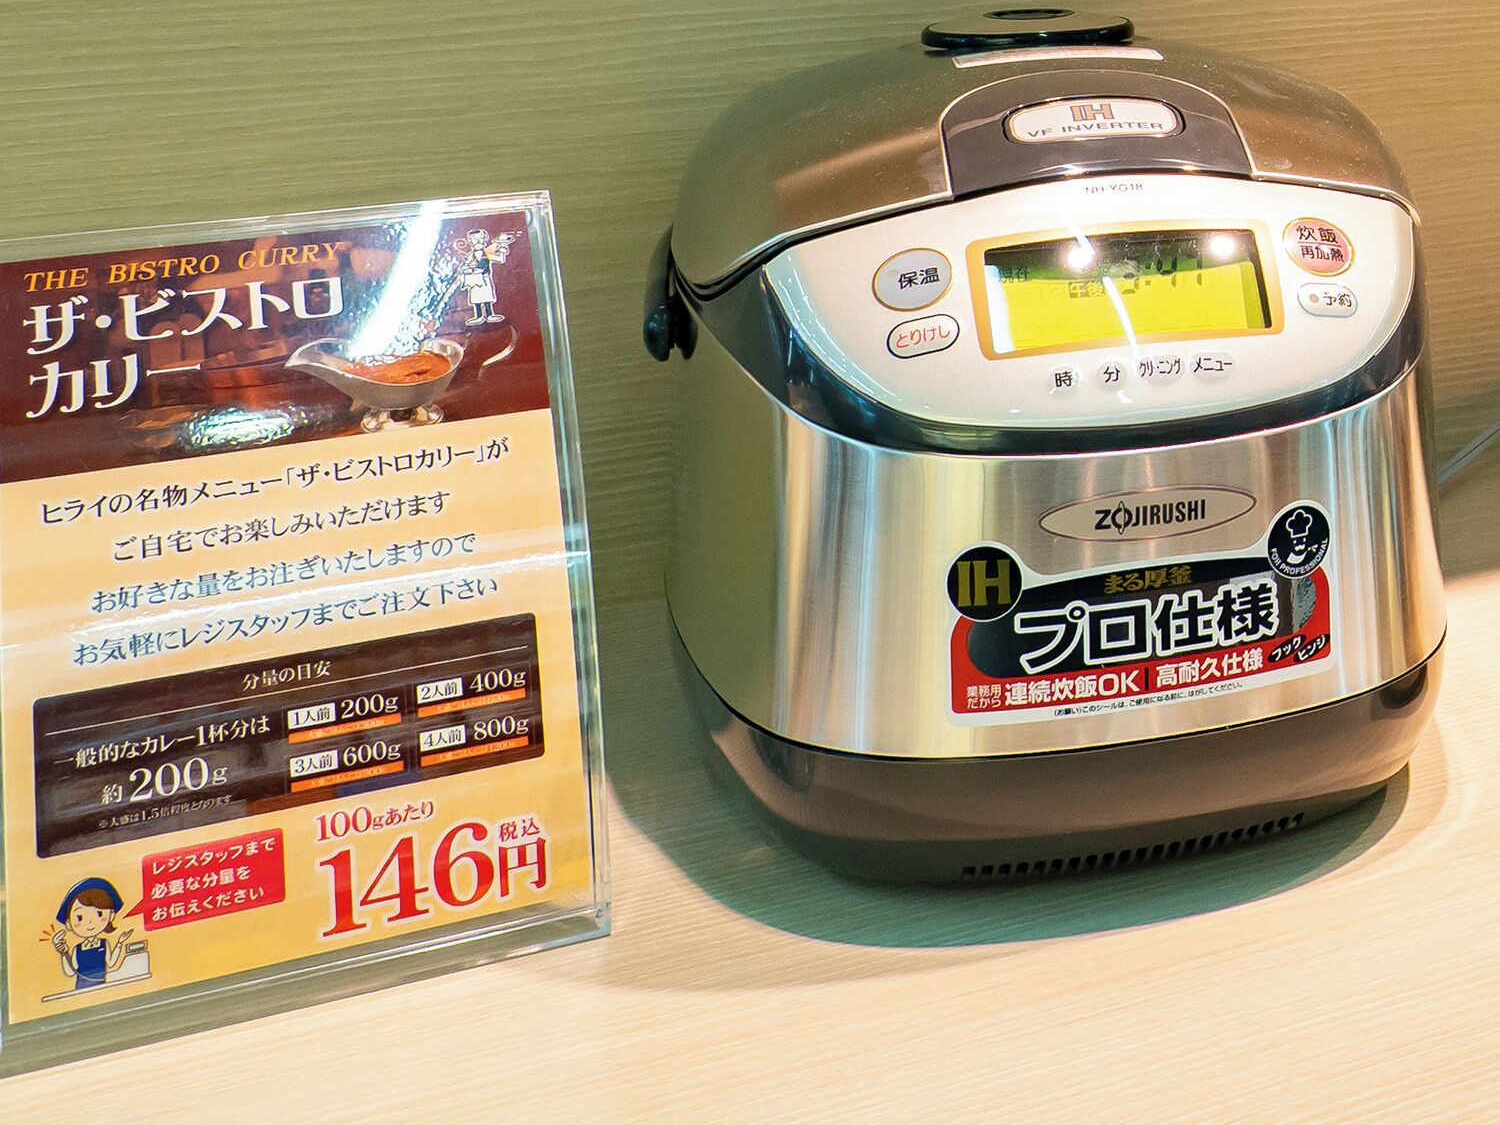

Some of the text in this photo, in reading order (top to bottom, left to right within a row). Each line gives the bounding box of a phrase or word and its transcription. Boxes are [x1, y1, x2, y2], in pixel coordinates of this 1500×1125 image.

[1027, 121, 1164, 138] VF INVERTER
[1296, 225, 1340, 244] 炊飯
[23, 241, 342, 294] THE BISTRO CURRY
[1300, 244, 1346, 263] 再加熱
[897, 266, 941, 290] 保温
[23, 277, 344, 356] ザ・ビストロ
[1322, 291, 1353, 308] 予約
[896, 324, 951, 349] とりけし
[26, 354, 203, 420] カリー
[1054, 370, 1073, 388] 時
[1102, 366, 1121, 383] 分
[1193, 357, 1233, 373] メニュー
[40, 436, 510, 526] ヒライの名物メニュー「ザ・ビストロカリー」が
[113, 490, 451, 564] ご自宅でお楽しみいただけます
[1094, 499, 1206, 535] ZOJIRUSHI
[91, 531, 478, 614] お好きな量をお注ぎいたしますので
[1270, 537, 1330, 575] FOR PROFESSIONAL
[956, 558, 1012, 608] IH
[1103, 563, 1195, 595] まる厚釜
[74, 575, 498, 668] お気軽にレジスタッフまでご注文下さい
[1014, 576, 1281, 674] プロ仕様
[1271, 636, 1302, 661] フック
[1297, 636, 1328, 662] ヒンジ
[240, 661, 332, 692] 分量の目安
[420, 668, 527, 701] 2人前 400g
[966, 683, 1002, 698] 業務用
[1004, 648, 1265, 707] 連続炊飯OK 高耐久仕様
[293, 693, 399, 726] 1人前 200g
[966, 696, 1002, 709] だから
[53, 714, 272, 771] 一般的なカレー1杯分は
[423, 715, 529, 748] 4人前 800g
[294, 740, 402, 774] 3人前 600g
[317, 801, 435, 843] 100gあたり
[499, 818, 541, 842] 税込
[150, 836, 277, 876] レジスタッフまで
[150, 864, 252, 900] 必要な分量を
[319, 820, 549, 938] 146円
[150, 885, 266, 922] お伝えください
